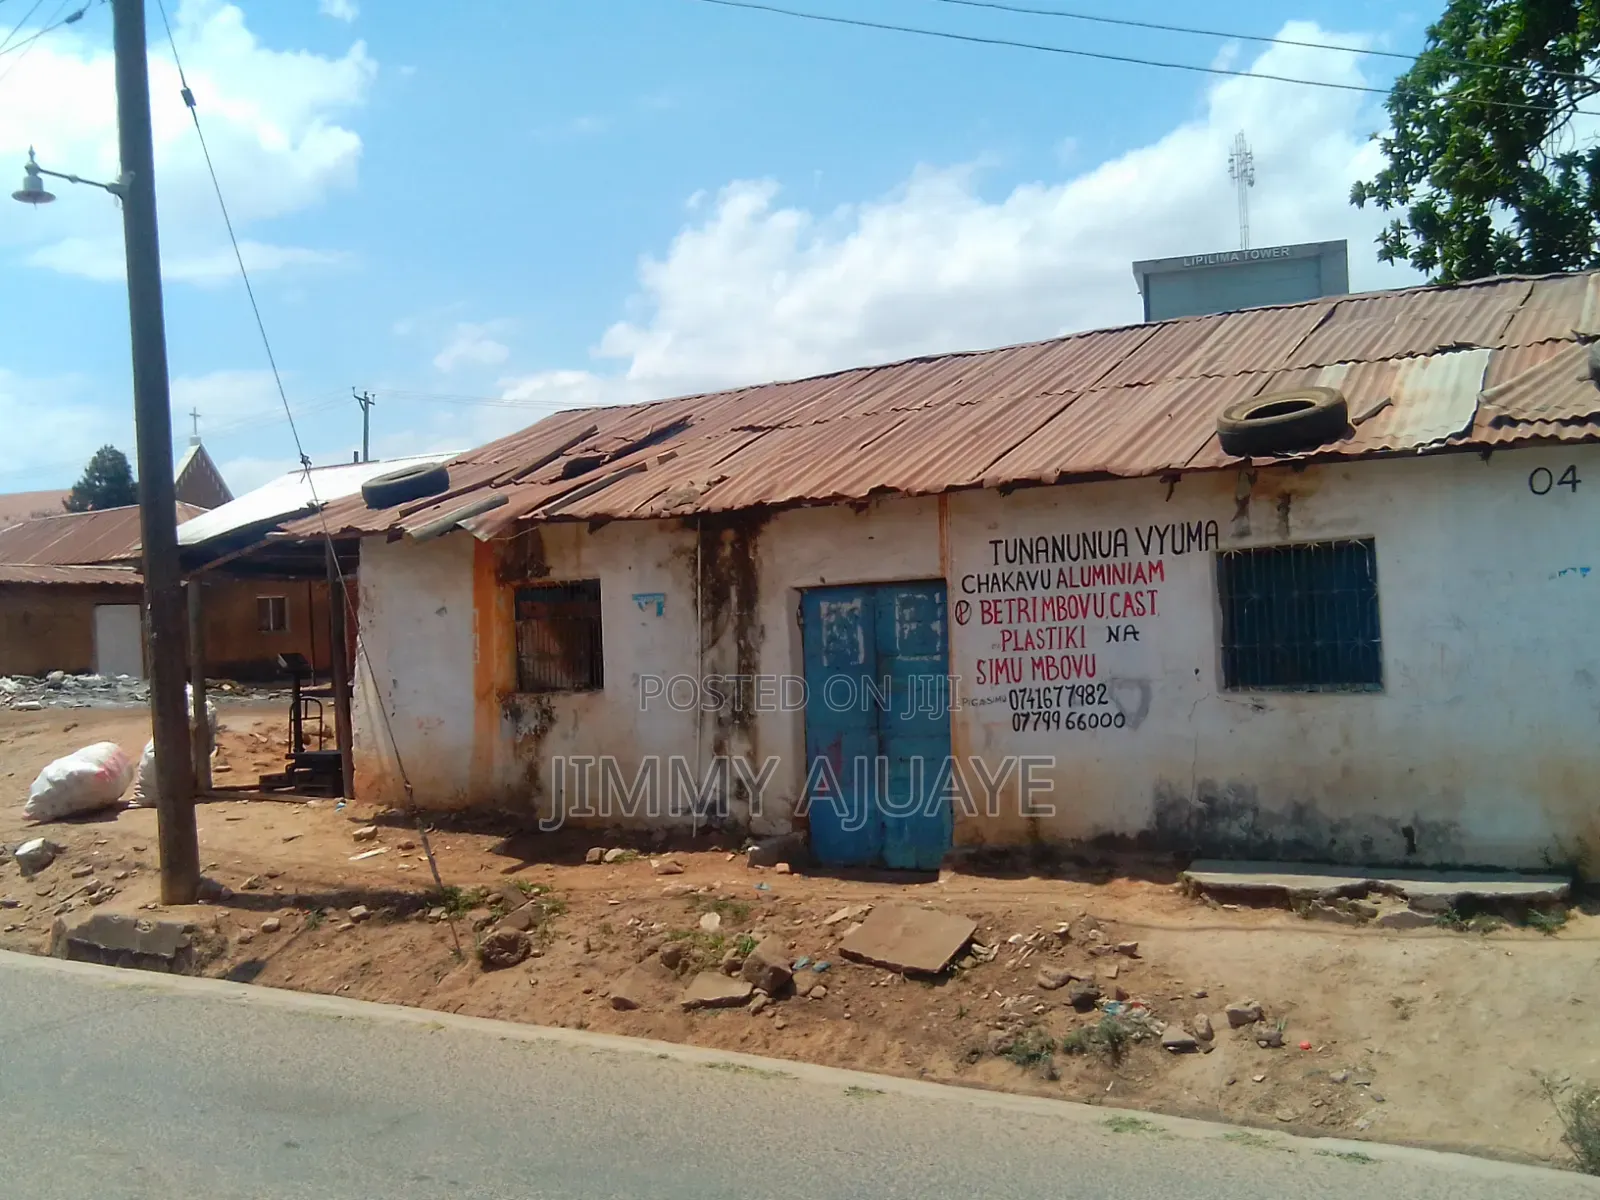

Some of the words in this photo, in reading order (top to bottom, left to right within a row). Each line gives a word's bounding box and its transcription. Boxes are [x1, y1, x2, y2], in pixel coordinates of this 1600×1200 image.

[1184, 251, 1239, 266] LIPILIMA
[1244, 247, 1290, 260] TOWER
[1528, 464, 1582, 495] 04
[989, 528, 1128, 566] TUNANUNUA
[1135, 520, 1219, 555] VYUMA
[961, 569, 1051, 594] CHAKAVU
[1056, 560, 1165, 590] ALUMINIAM
[980, 597, 1037, 625] BETRI
[1000, 625, 1086, 652] PLASTIKI
[1106, 624, 1140, 643] NA
[976, 658, 1023, 685] SIMU
[1031, 654, 1097, 681] MBOVU
[1008, 684, 1109, 711] 0741677982
